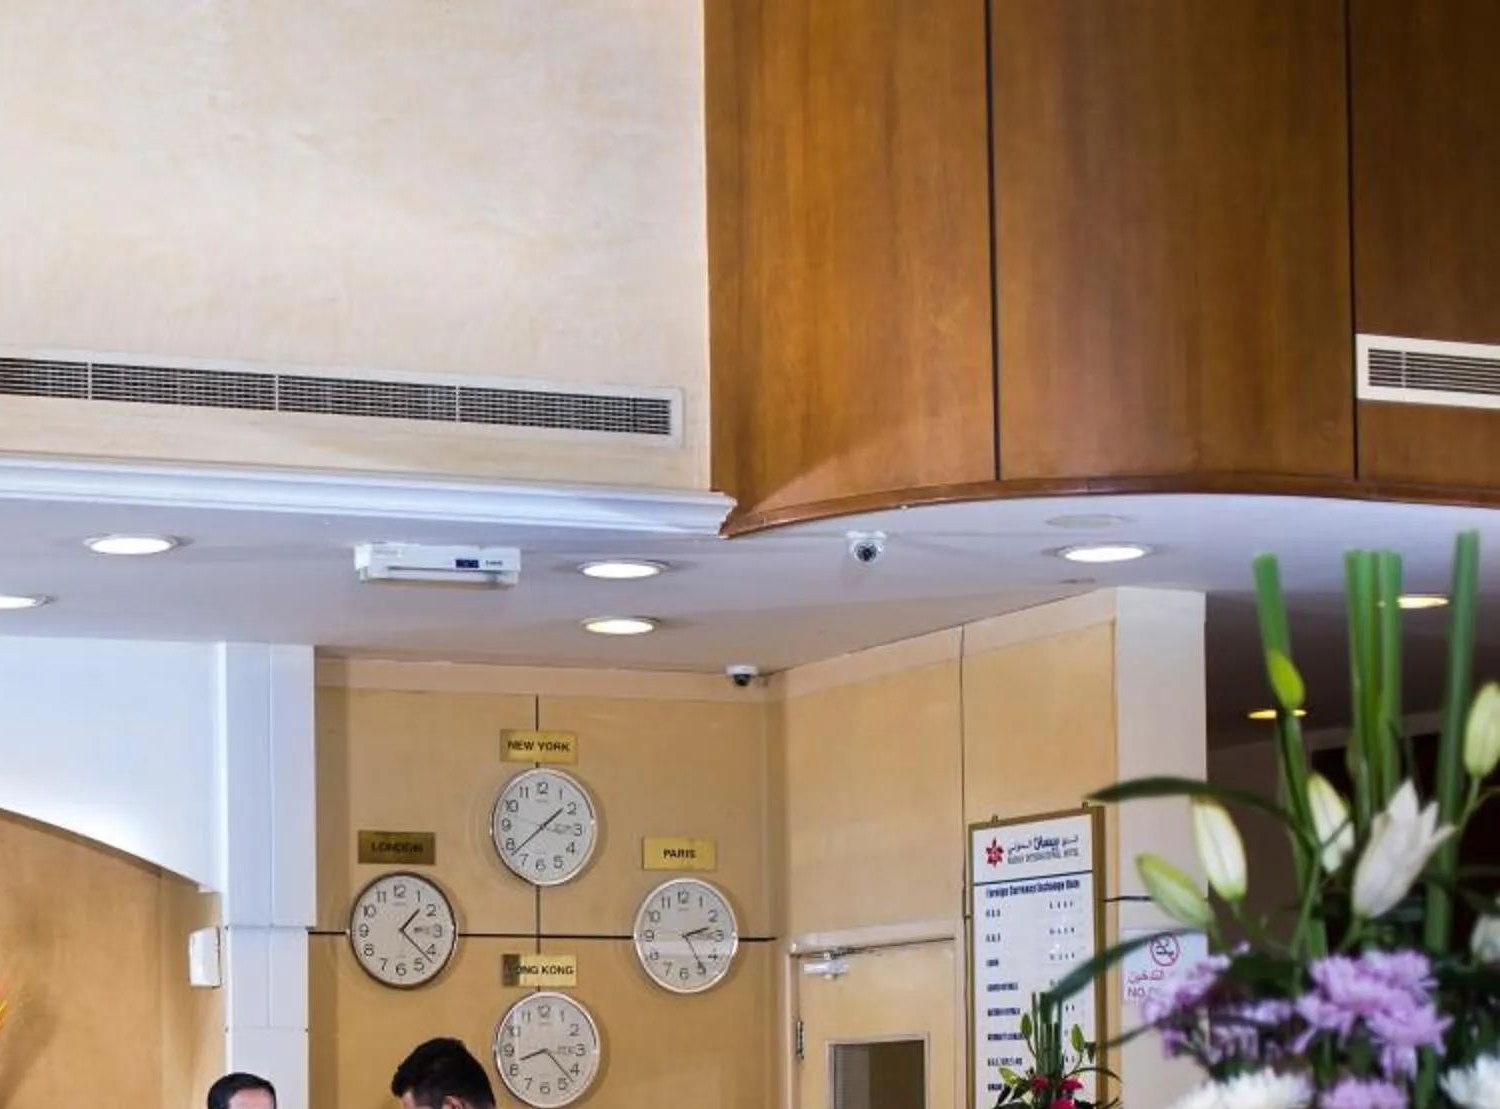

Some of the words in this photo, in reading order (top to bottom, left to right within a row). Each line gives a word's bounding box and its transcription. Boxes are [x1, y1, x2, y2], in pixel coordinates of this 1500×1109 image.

[508, 740, 534, 750] NEW
[537, 742, 571, 752] YORK
[519, 786, 529, 799] 11
[537, 781, 548, 795] 12
[506, 800, 518, 813] 10
[567, 801, 577, 815] 2
[502, 819, 511, 832] 9
[573, 823, 583, 836] 3
[371, 842, 424, 853] LONDON
[566, 841, 576, 855] 4
[663, 848, 697, 859] PARIS
[520, 853, 529, 866] 7
[535, 859, 546, 872] 6
[553, 855, 564, 869] 5
[376, 890, 387, 903] 11
[393, 885, 406, 898] 12
[363, 904, 377, 918] 10
[426, 903, 437, 917] 2
[359, 923, 369, 938] 9
[433, 924, 443, 938] 3
[364, 943, 374, 956] 8
[425, 944, 437, 955] 4
[379, 958, 388, 971] 7
[396, 963, 407, 976] 6
[414, 958, 425, 972] 5
[507, 964, 539, 975] ONG
[541, 965, 575, 975] KONG
[1127, 987, 1145, 997] NO
